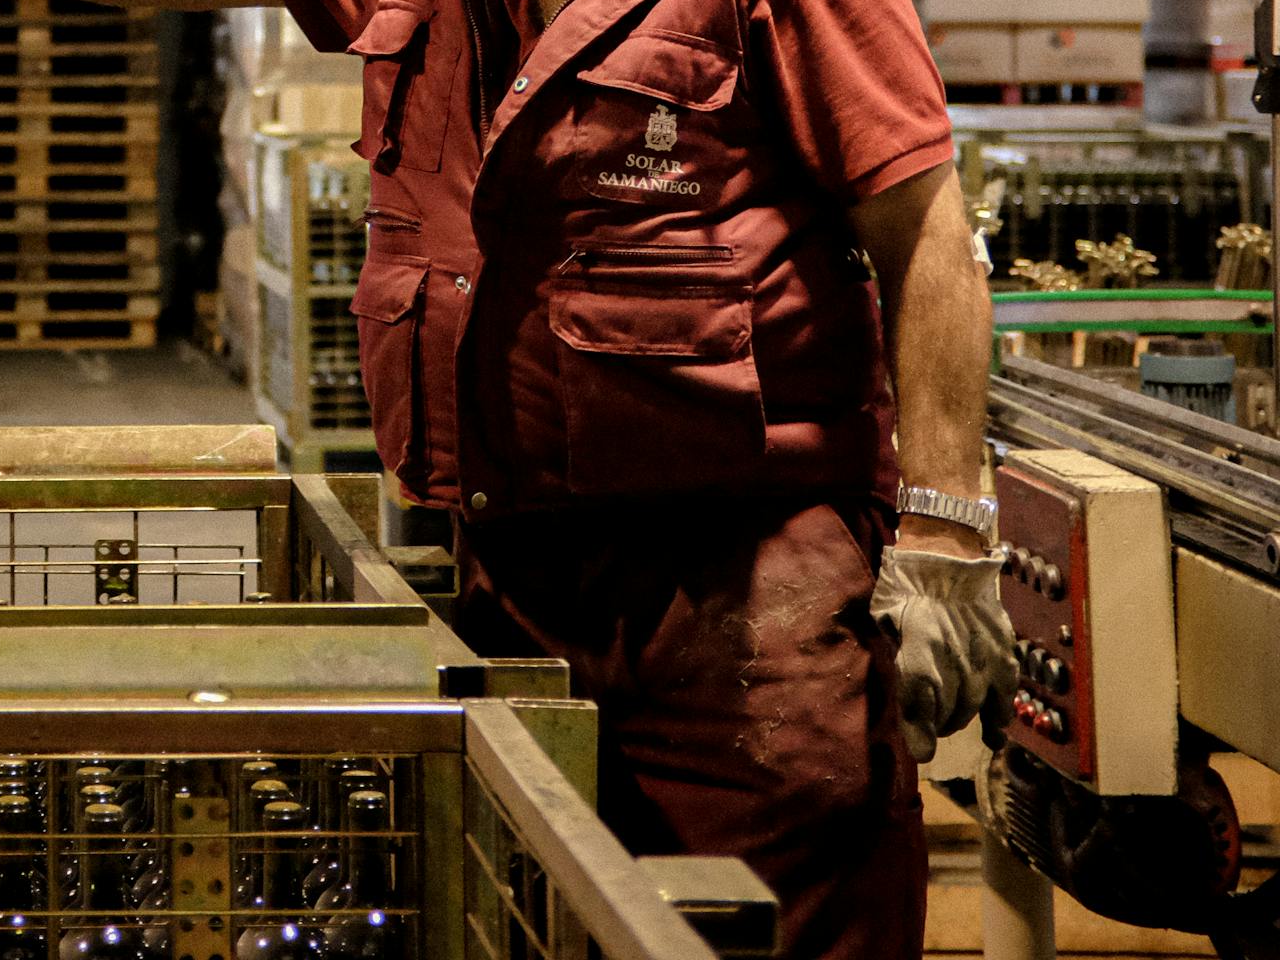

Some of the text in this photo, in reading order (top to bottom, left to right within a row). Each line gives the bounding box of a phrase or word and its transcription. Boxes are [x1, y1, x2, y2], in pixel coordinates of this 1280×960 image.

[625, 153, 684, 174] SOLAR
[597, 171, 701, 195] SAMANIEGO
[648, 170, 661, 179] DE
